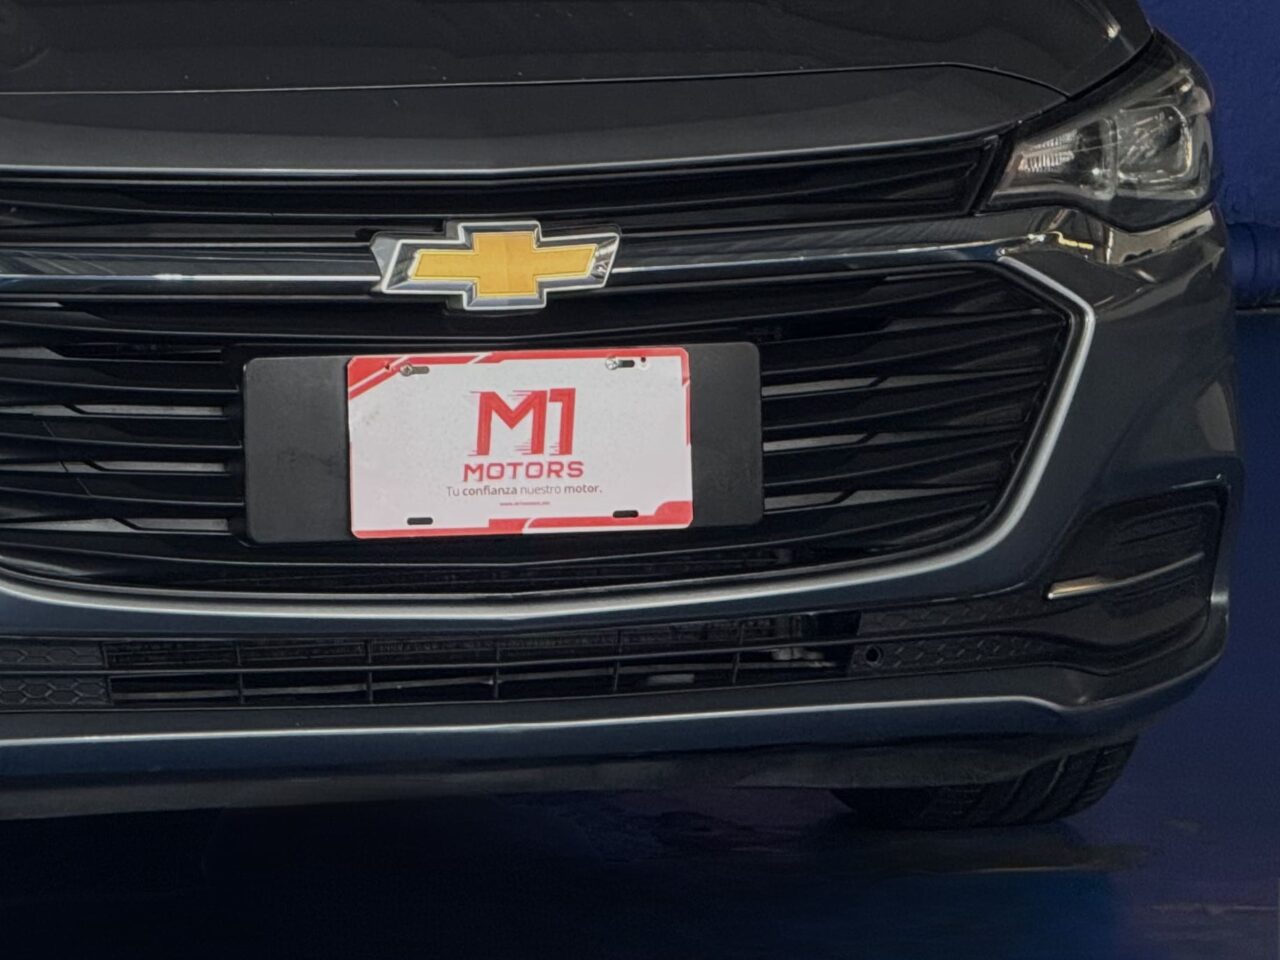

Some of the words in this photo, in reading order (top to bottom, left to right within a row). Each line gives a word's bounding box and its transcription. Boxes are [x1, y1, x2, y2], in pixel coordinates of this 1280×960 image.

[467, 387, 576, 456] M1
[462, 460, 585, 482] MOTORS
[446, 485, 461, 497] Tu
[462, 485, 518, 496] confianza
[520, 486, 562, 495] nuestro
[564, 484, 603, 494] motor.
